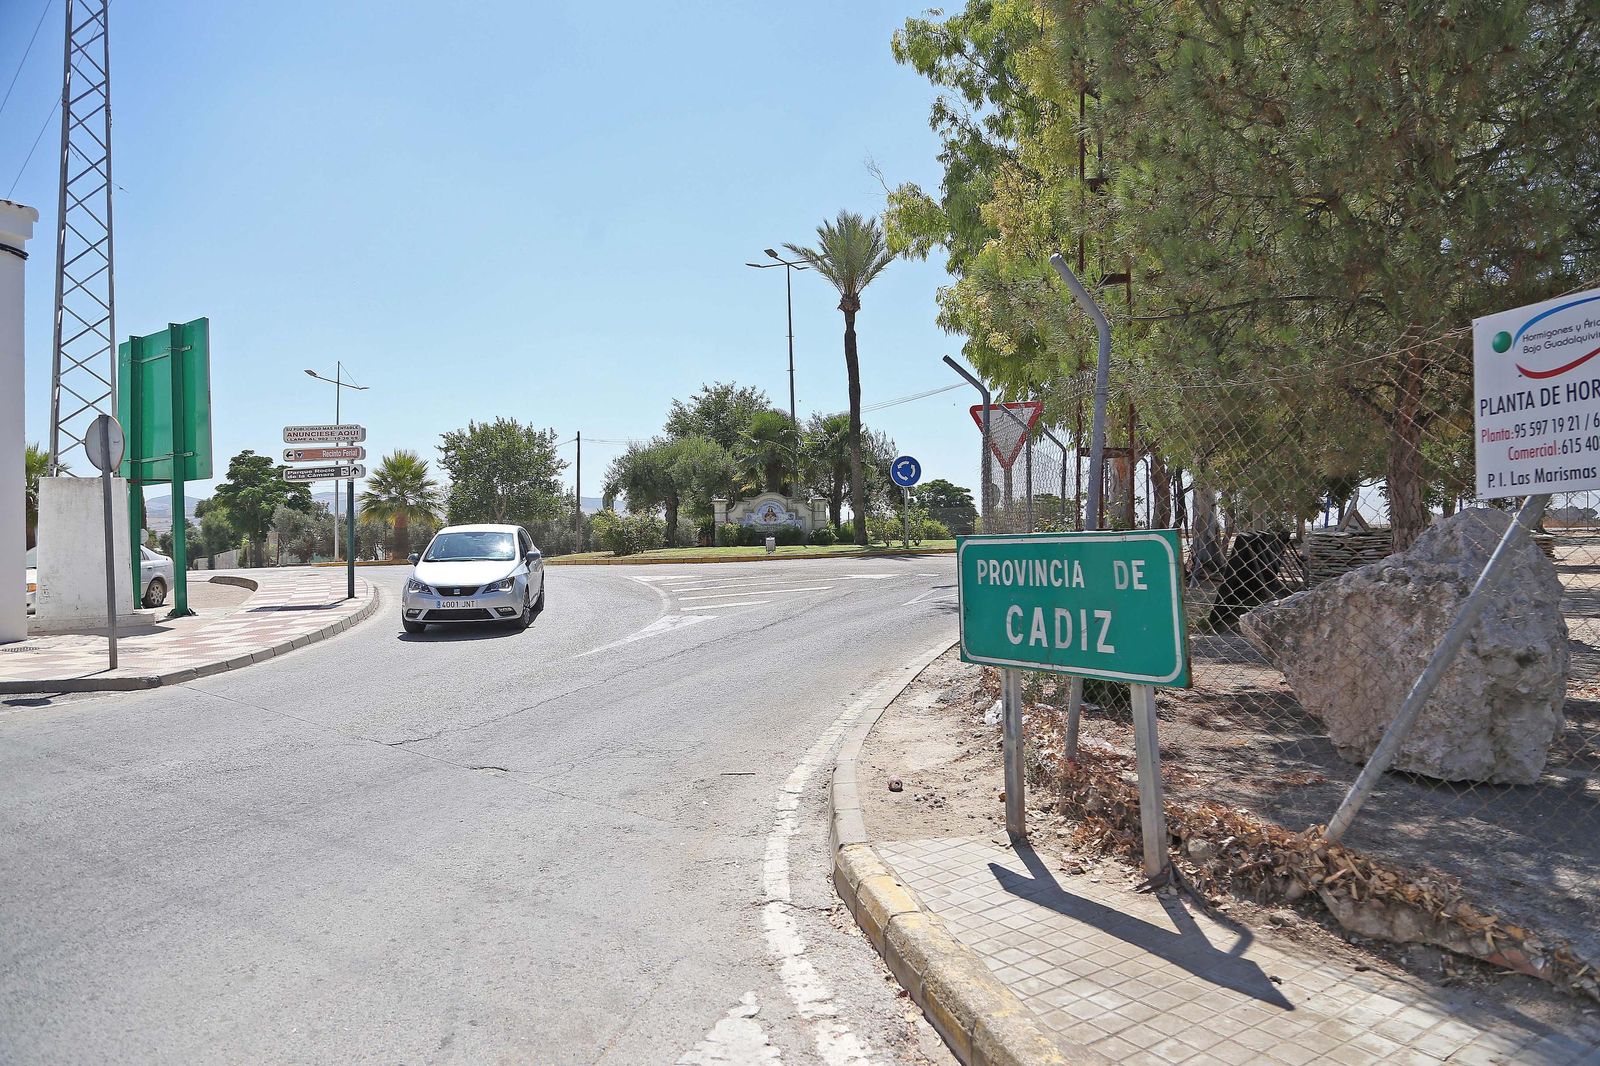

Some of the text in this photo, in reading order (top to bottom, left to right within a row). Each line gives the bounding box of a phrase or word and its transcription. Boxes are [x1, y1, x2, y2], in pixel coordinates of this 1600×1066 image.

[1522, 325, 1574, 342] Hormigones
[1576, 324, 1581, 333] y
[1523, 344, 1541, 354] Bajo
[1480, 379, 1600, 417] PLANTA DE HOR
[1529, 420, 1548, 437] 597
[1552, 417, 1564, 433] 19
[1568, 415, 1579, 431] 21
[1584, 413, 1590, 431] /
[322, 449, 358, 457] Recinto Ferial
[1488, 473, 1495, 488] P.
[1510, 471, 1530, 486] Las
[1534, 466, 1597, 483] Marismas
[977, 559, 1148, 590] PROVINCIA DE
[1006, 604, 1115, 654] CADIZ
